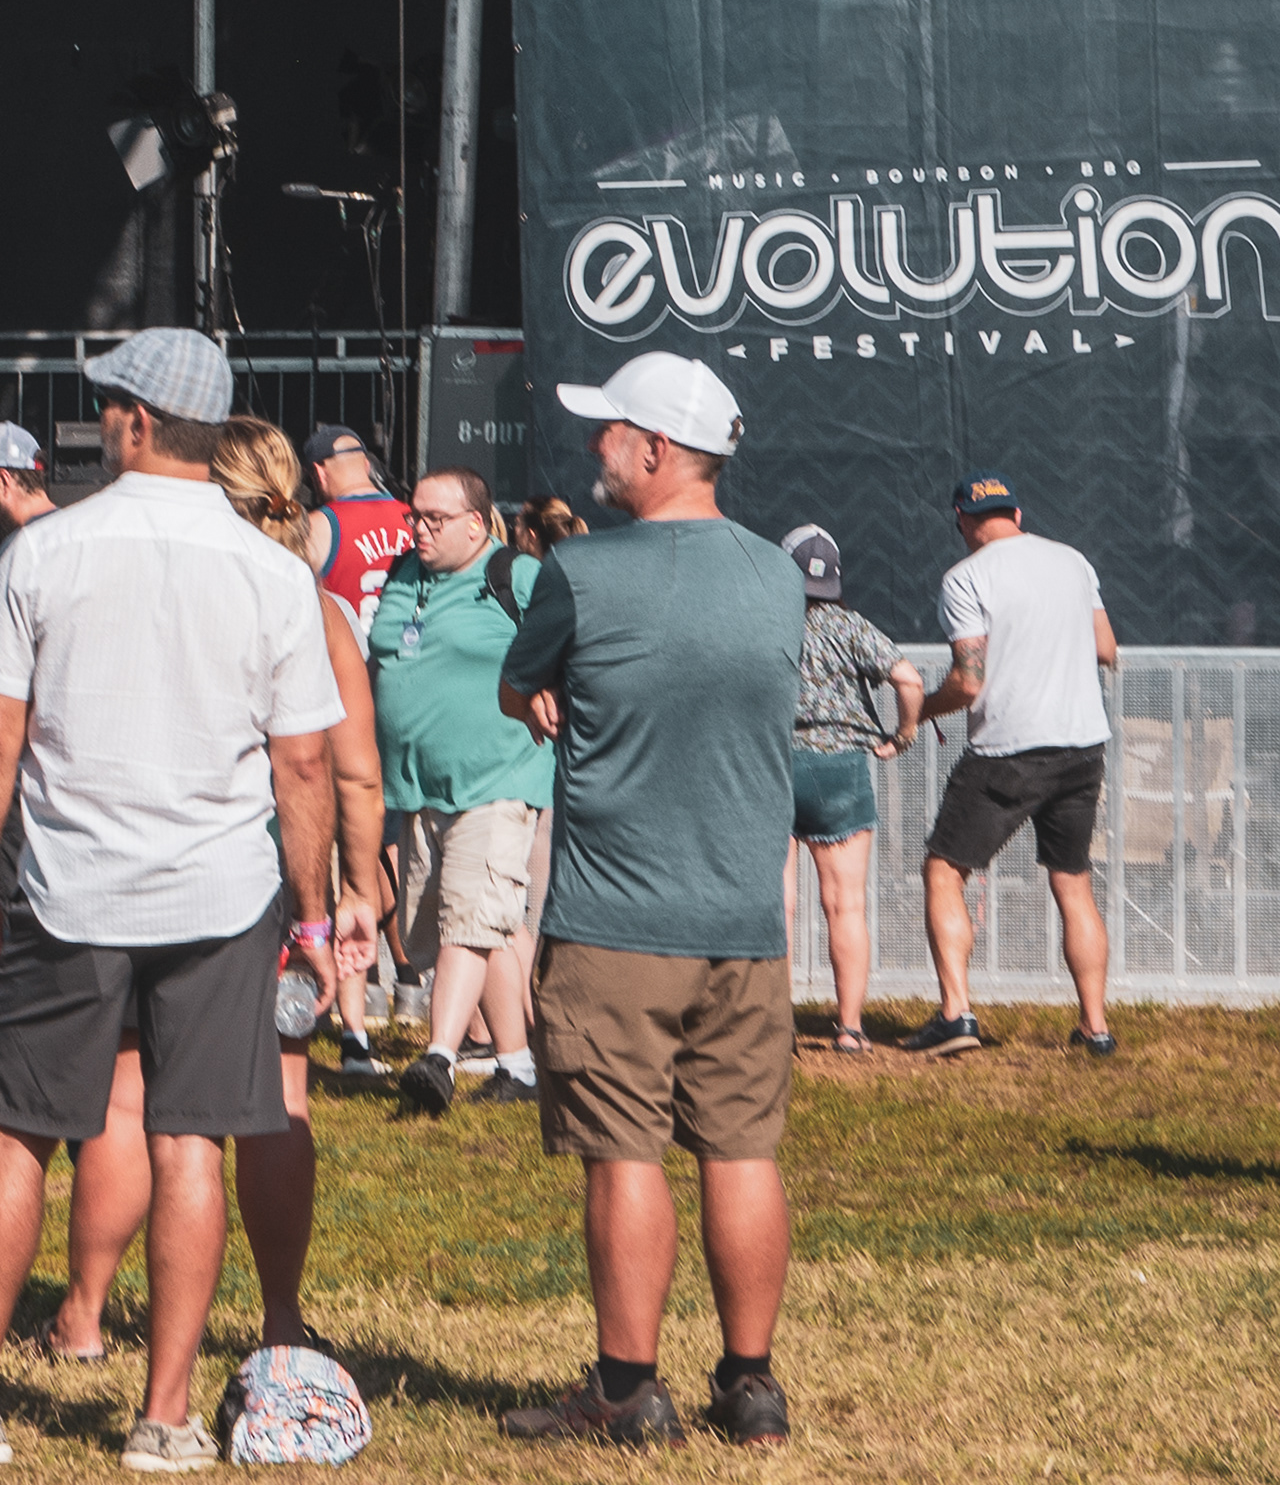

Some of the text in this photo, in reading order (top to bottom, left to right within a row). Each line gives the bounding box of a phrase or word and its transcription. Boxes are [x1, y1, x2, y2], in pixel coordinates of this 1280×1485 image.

[709, 159, 1142, 190] MUSIC BOURBON BBQ
[769, 329, 1093, 362] FESTIVAL
[353, 527, 416, 566] MILE
